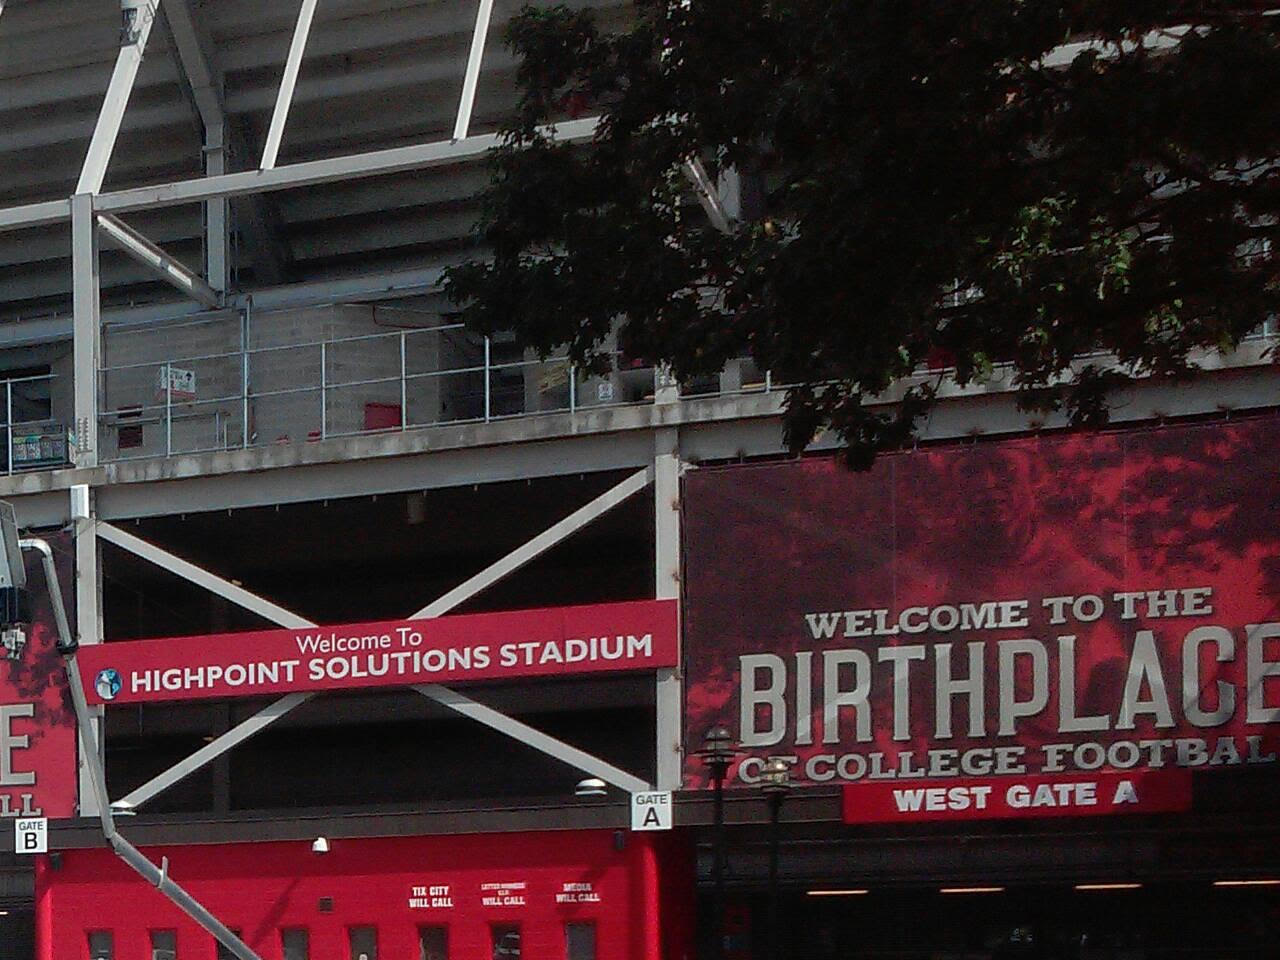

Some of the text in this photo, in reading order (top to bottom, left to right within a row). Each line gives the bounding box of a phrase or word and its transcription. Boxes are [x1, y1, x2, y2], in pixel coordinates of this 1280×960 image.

[805, 586, 1213, 639] WELCOME TO THE
[296, 627, 422, 653] Welcome To
[131, 634, 652, 693] HIGHPOINT SOLUTIONS STADIUM
[738, 621, 1280, 748] BIRTHPLACE
[805, 746, 1026, 781] COLLEGE
[636, 794, 667, 805] GATE
[893, 782, 1139, 811] WEST GATE A
[643, 807, 660, 826] A
[19, 821, 44, 831] GATE
[25, 832, 38, 849] B
[412, 886, 449, 896] TIX CITY
[556, 892, 600, 903] WILL CALL
[409, 898, 453, 908] WILL CALL
[482, 896, 525, 906] WILL CALL
